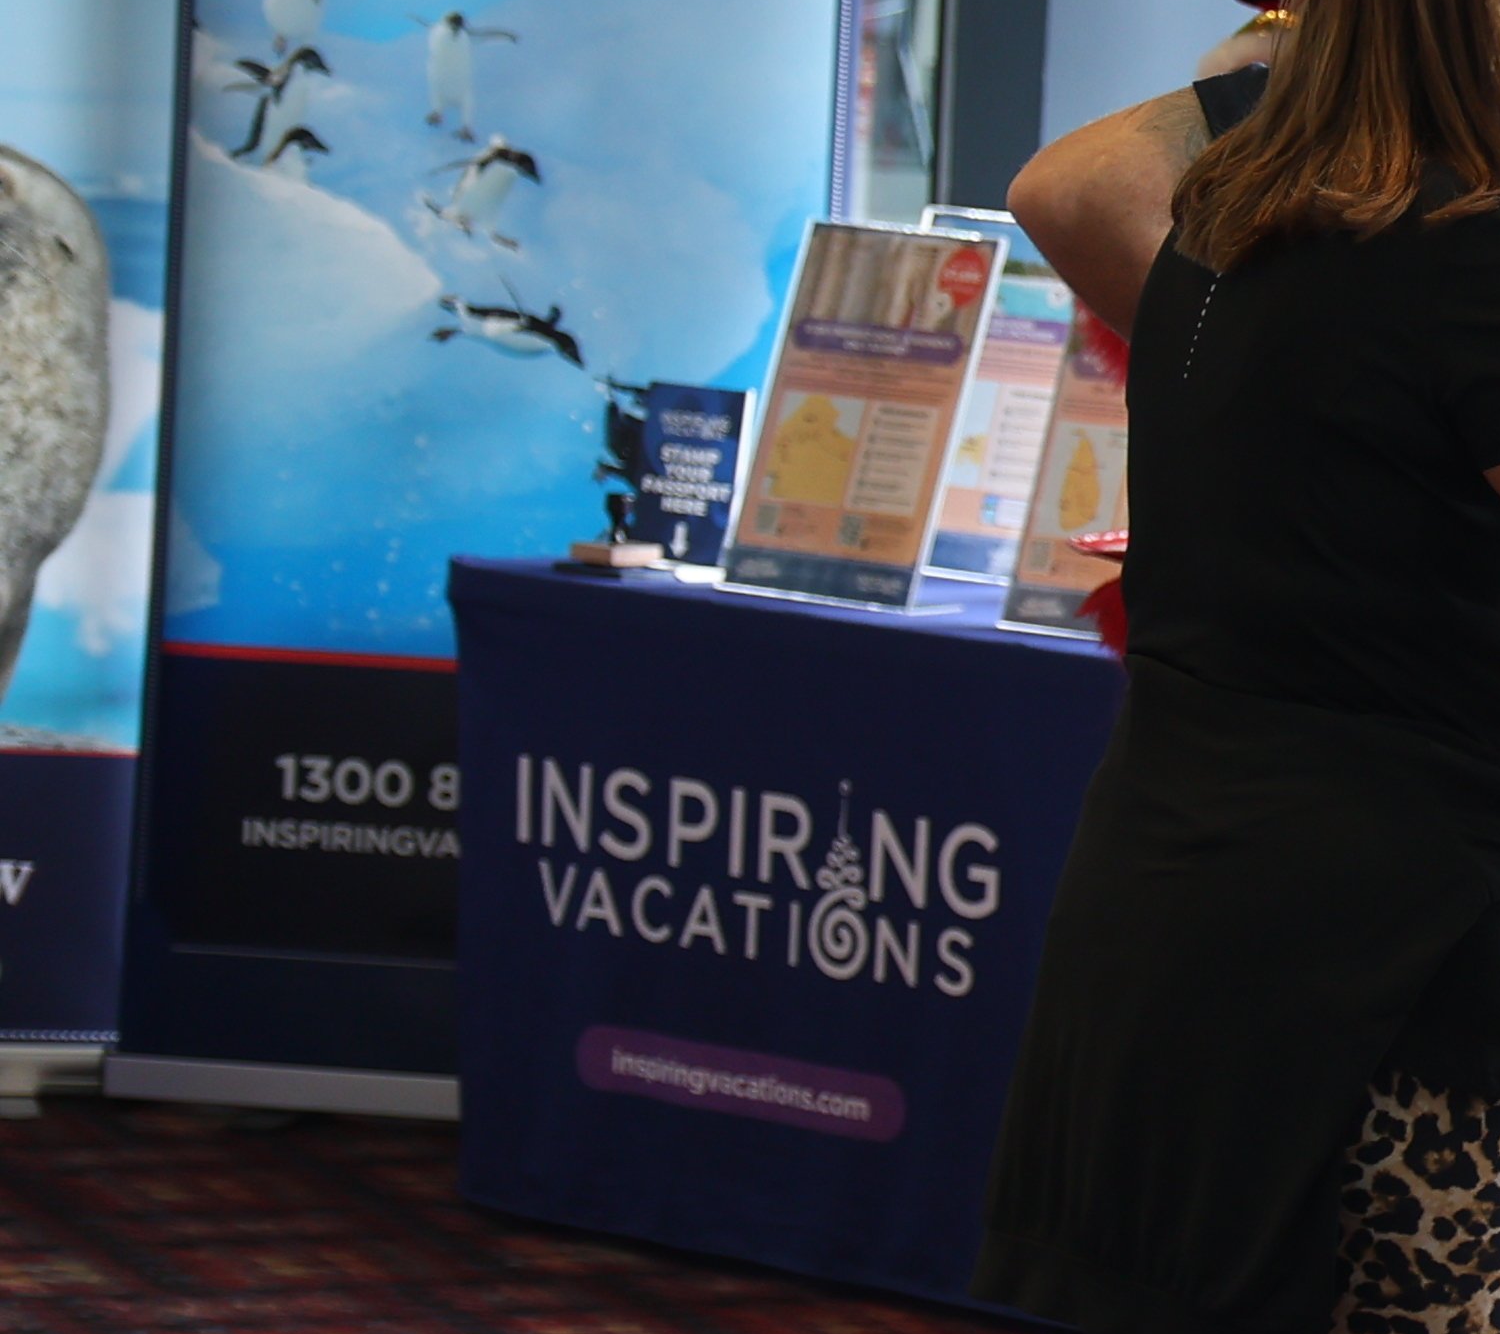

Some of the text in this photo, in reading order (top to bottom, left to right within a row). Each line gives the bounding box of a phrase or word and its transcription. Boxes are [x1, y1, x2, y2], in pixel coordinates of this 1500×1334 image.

[660, 443, 721, 466] STAMP
[640, 473, 732, 504] PASSPORT
[660, 496, 708, 517] HERE
[275, 753, 461, 811] 1300 8
[515, 755, 1000, 922] INSPIRING
[538, 859, 976, 999] VACATIONS
[611, 1046, 872, 1124] inspiringvacations.com
